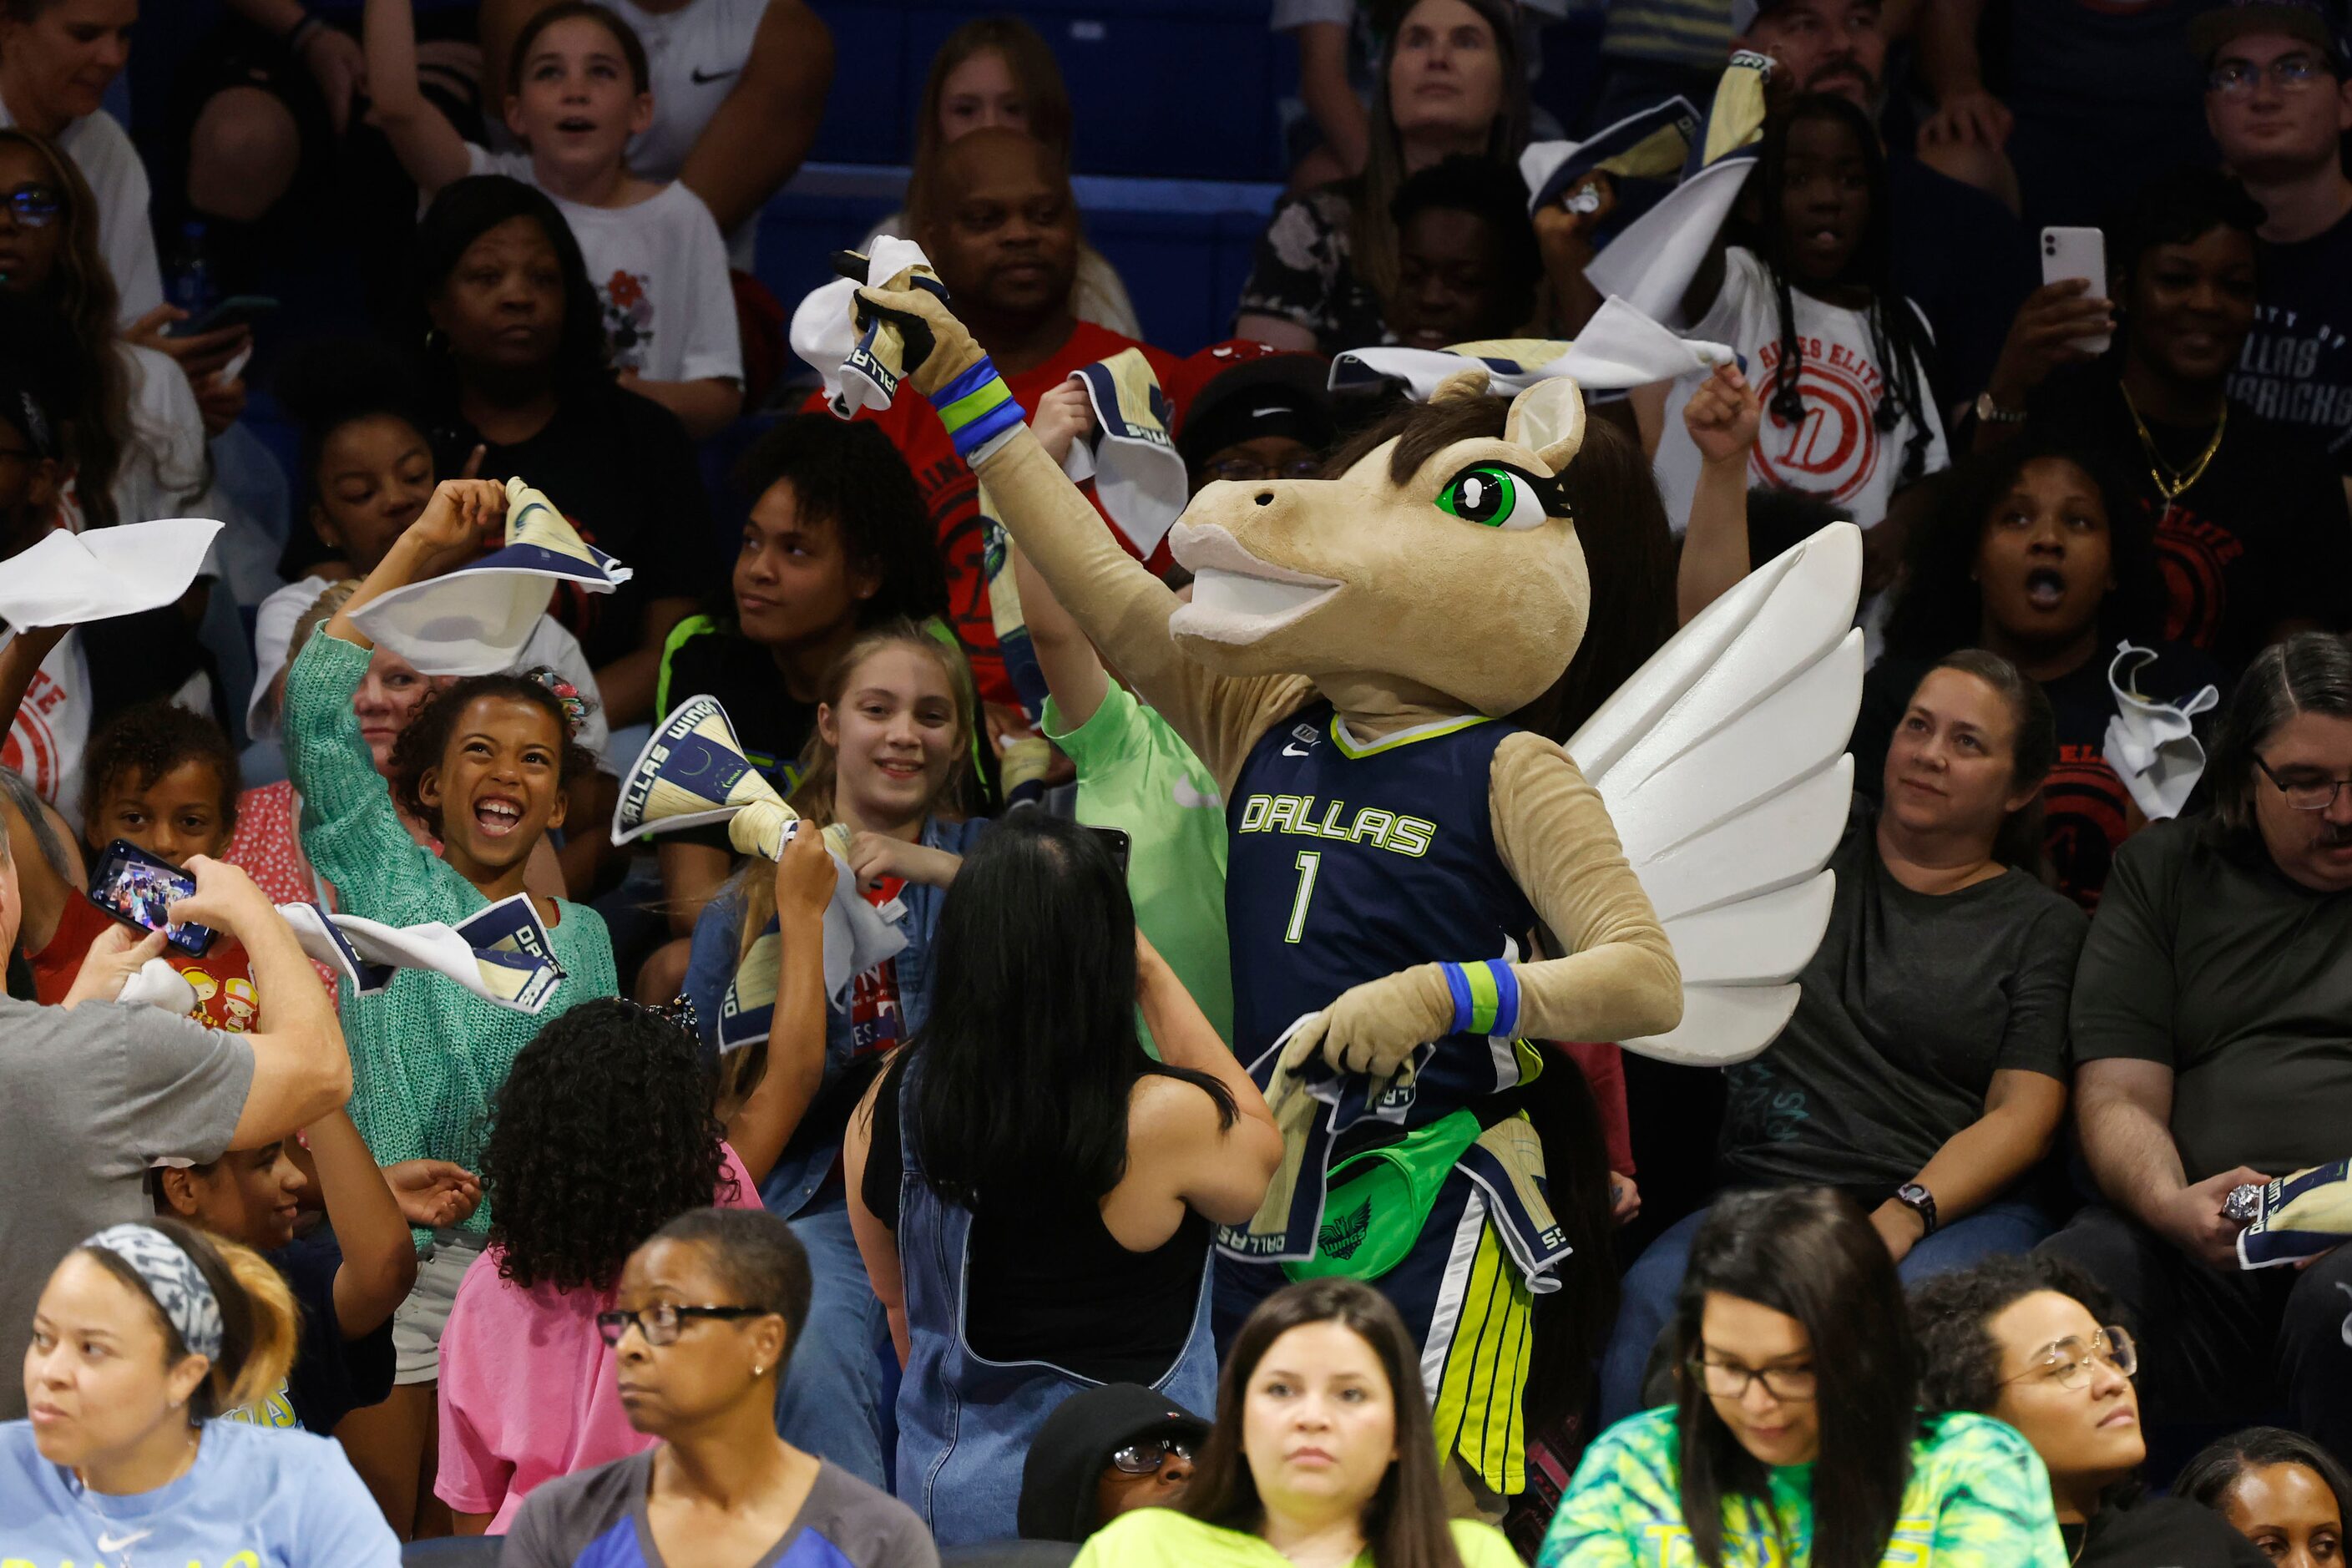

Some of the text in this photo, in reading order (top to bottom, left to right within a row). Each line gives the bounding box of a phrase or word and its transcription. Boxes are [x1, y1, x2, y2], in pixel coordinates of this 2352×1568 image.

[2240, 331, 2319, 379] LLAS
[1238, 794, 1438, 858] DALLAS
[1284, 850, 1322, 943] 1
[1217, 1225, 1287, 1254] DALLAS
[1323, 1227, 1366, 1256] WINGS
